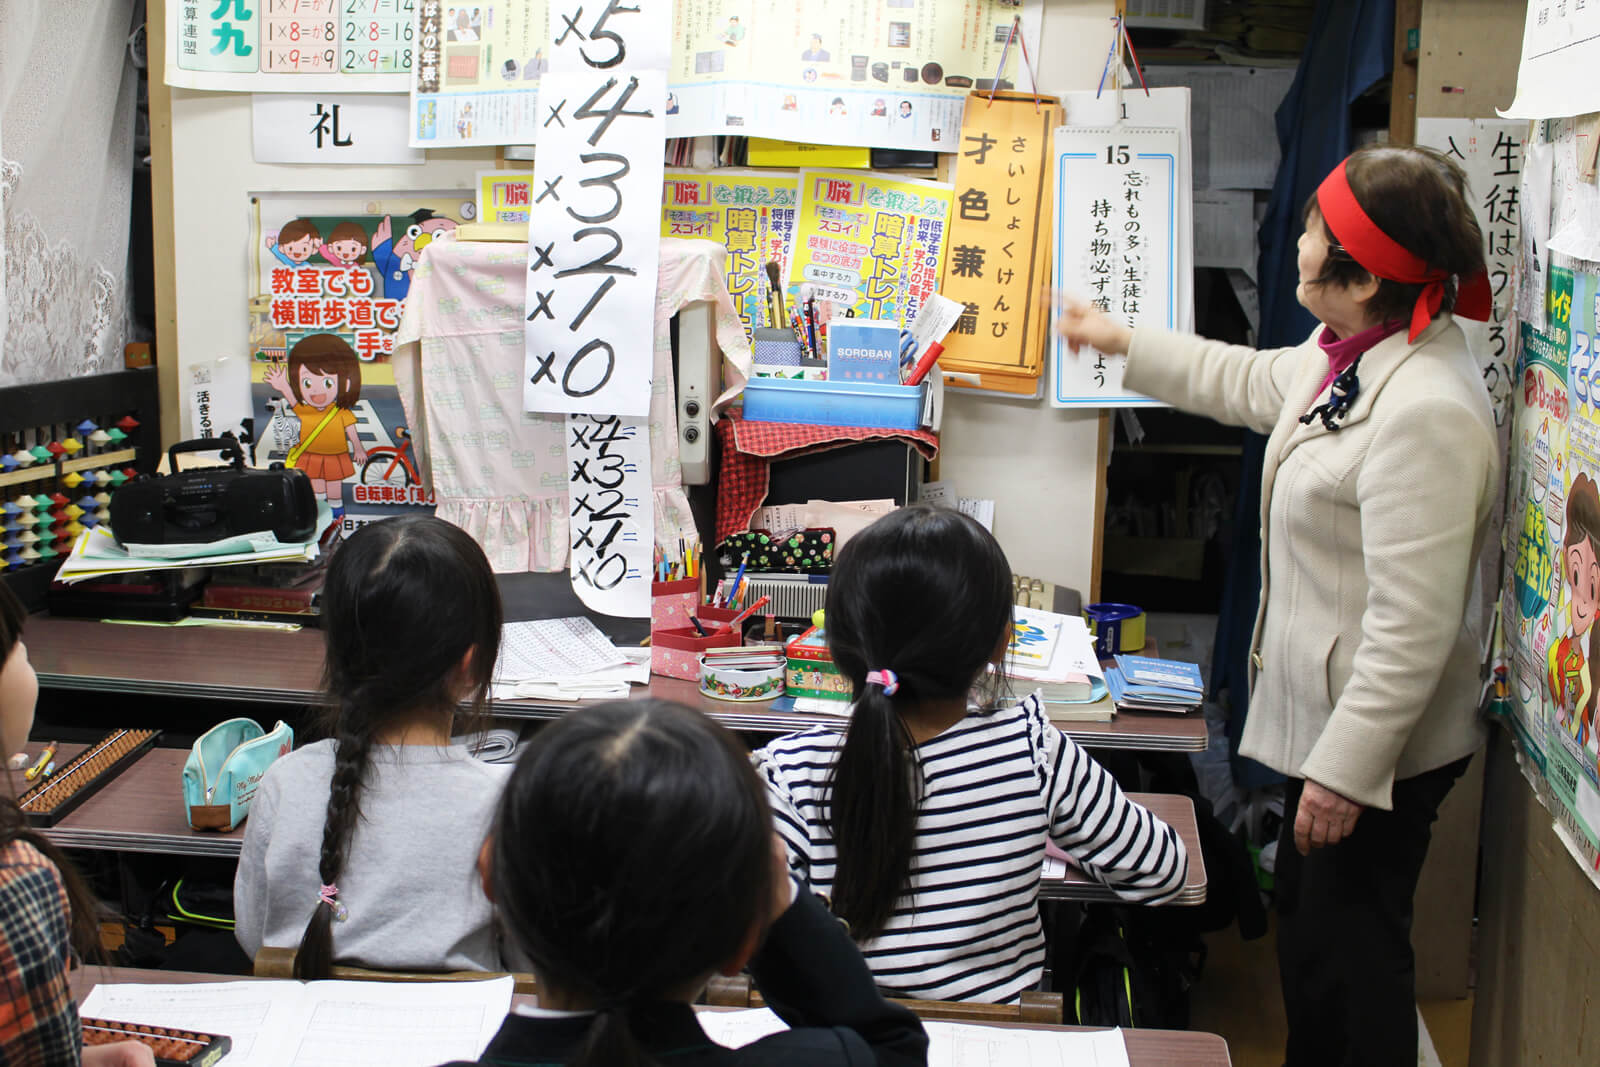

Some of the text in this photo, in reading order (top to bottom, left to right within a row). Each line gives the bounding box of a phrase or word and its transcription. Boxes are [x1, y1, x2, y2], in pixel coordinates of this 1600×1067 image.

[1119, 102, 1129, 120] 1
[310, 103, 353, 149] 礼
[1104, 145, 1131, 165] 15
[950, 131, 997, 336] 才色兼備
[991, 135, 1028, 338] さいしょくけんび
[272, 268, 372, 295] 教室でも
[272, 301, 405, 327] 横断歩道で
[357, 331, 398, 359] 手を
[837, 347, 892, 360] SOROBAN
